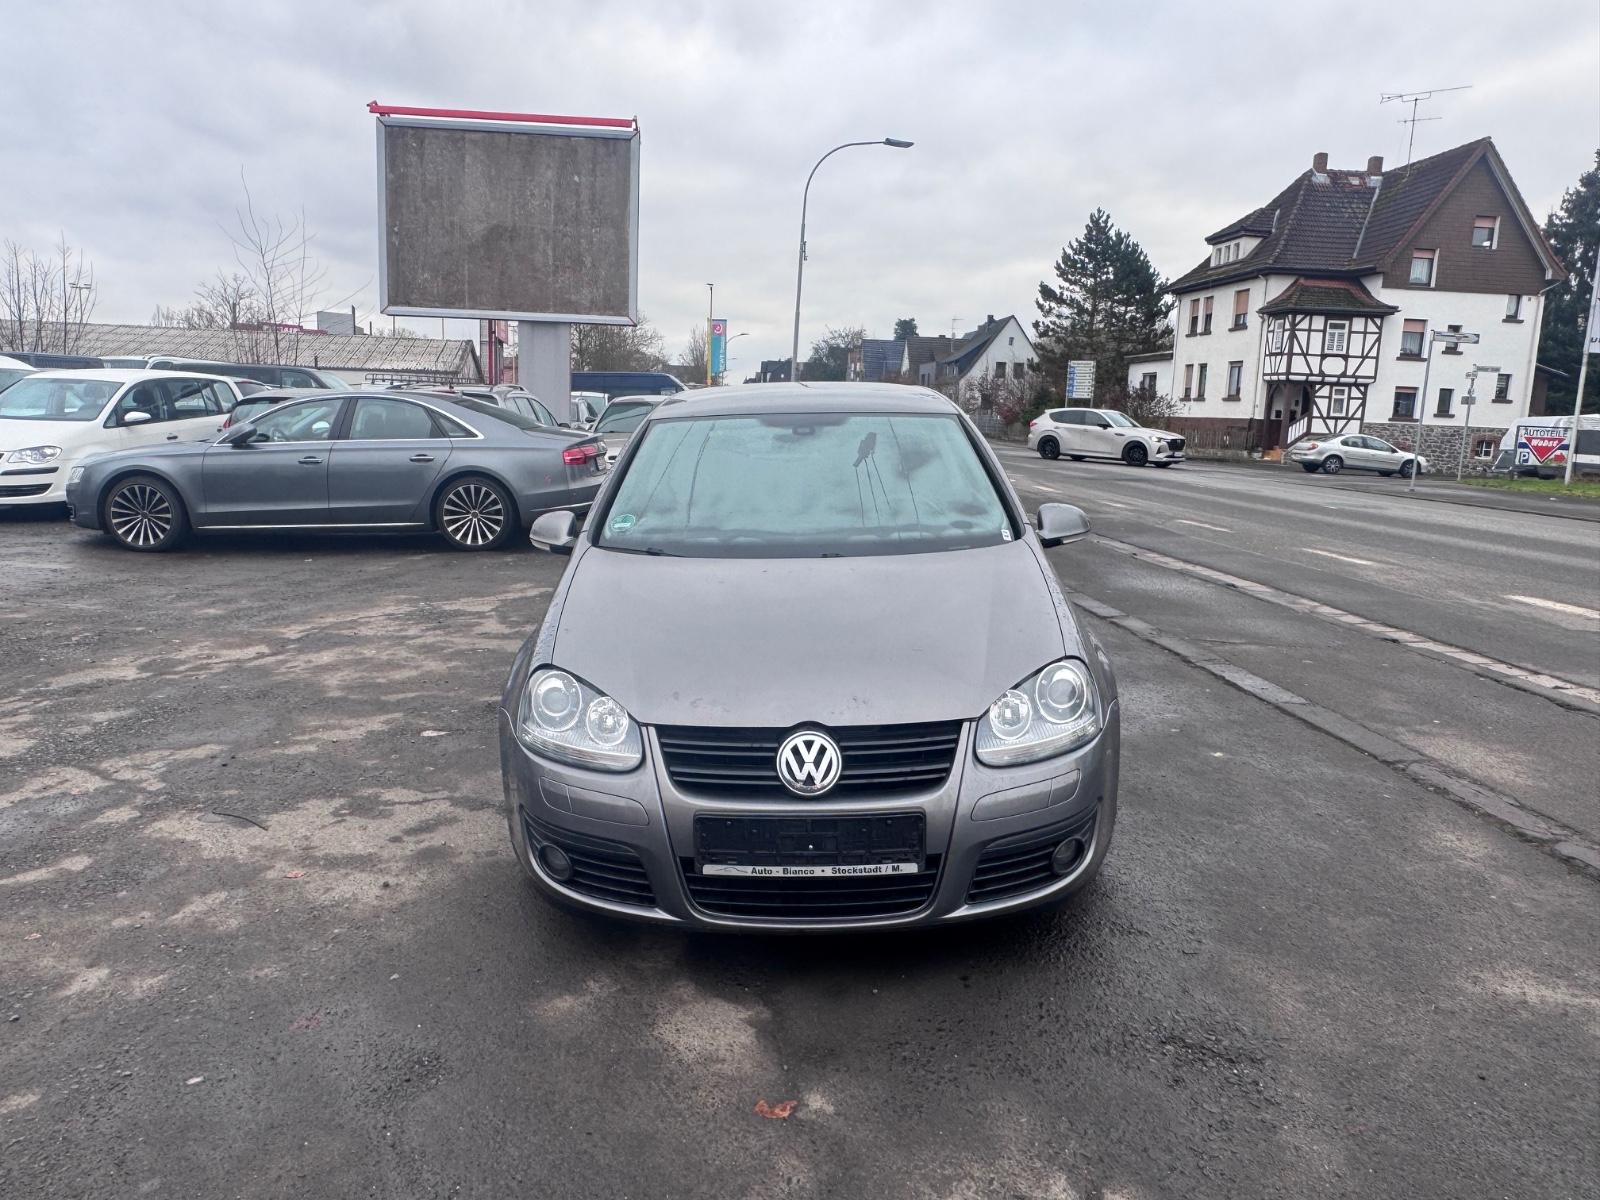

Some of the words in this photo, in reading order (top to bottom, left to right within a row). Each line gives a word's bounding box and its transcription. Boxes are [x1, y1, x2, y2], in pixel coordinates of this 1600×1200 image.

[1523, 429, 1567, 437] AUTOTEILE
[1520, 453, 1529, 463] P
[779, 733, 840, 793] VW
[751, 866, 772, 875] Auto
[831, 864, 882, 875] Stockstadt
[891, 864, 903, 874] M.
